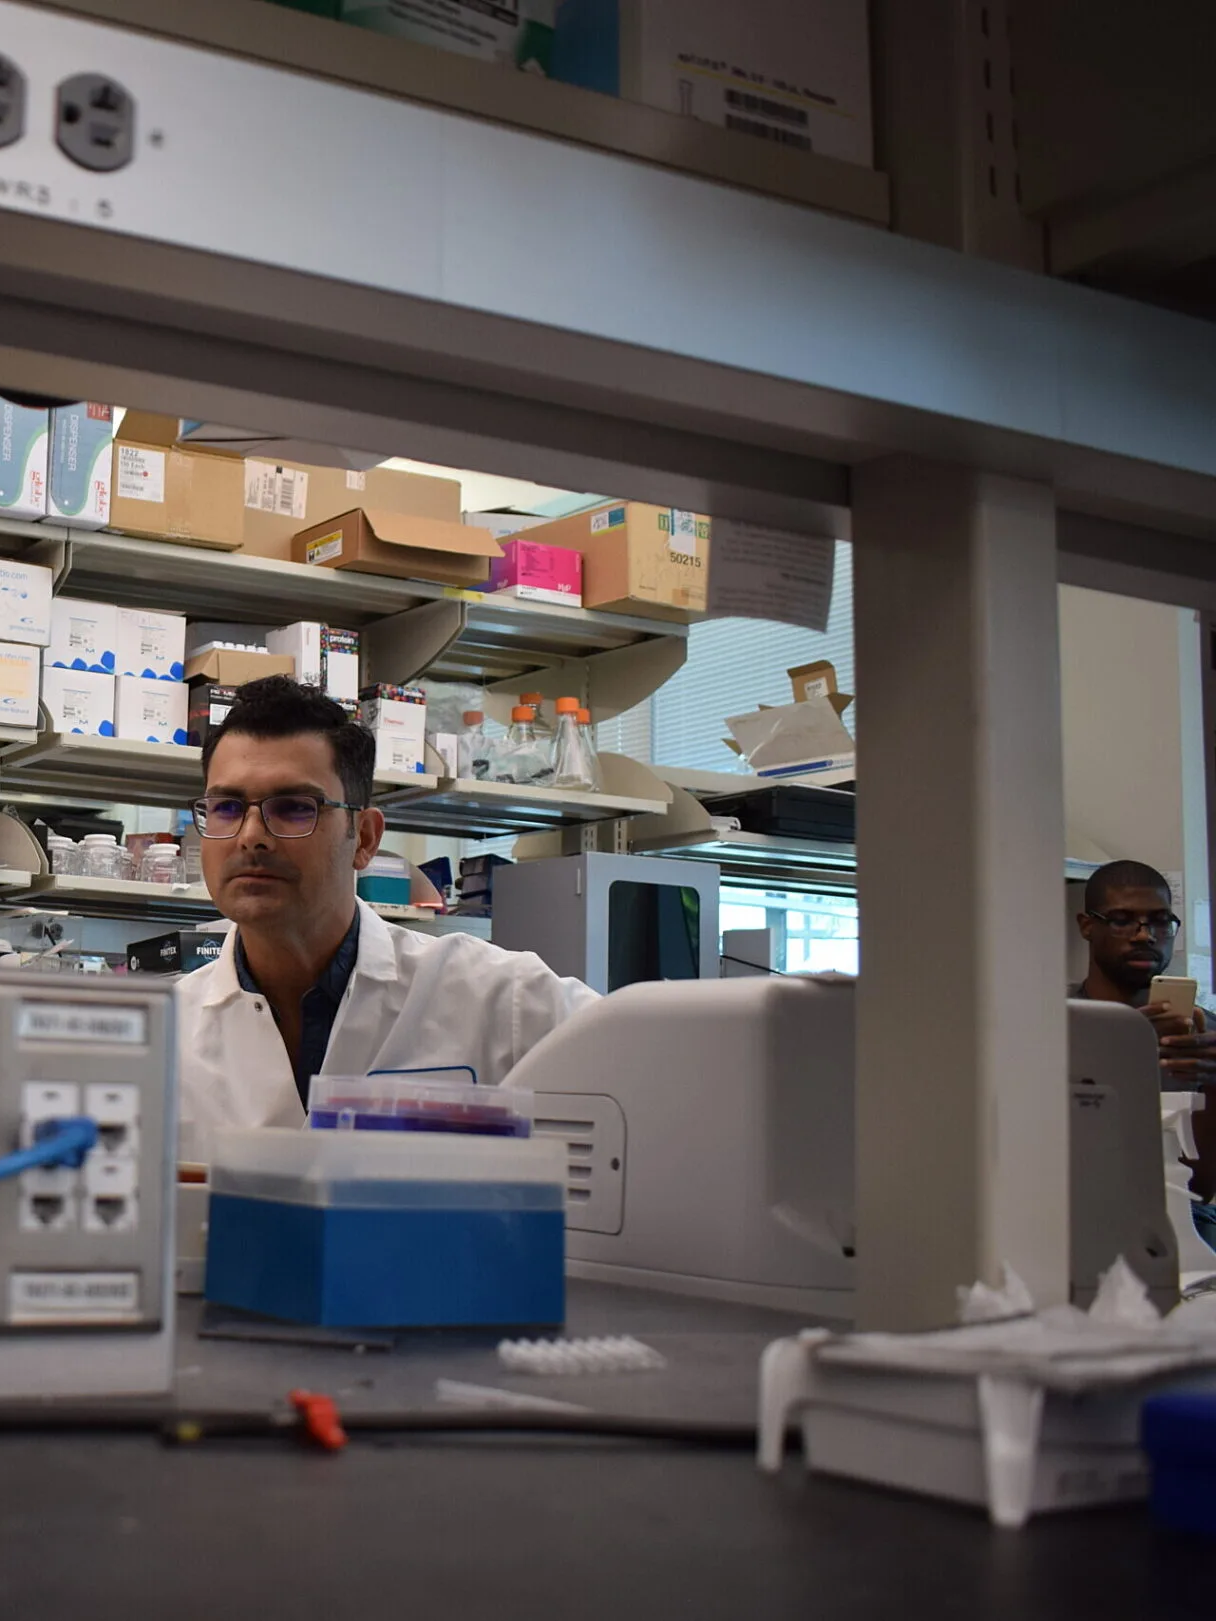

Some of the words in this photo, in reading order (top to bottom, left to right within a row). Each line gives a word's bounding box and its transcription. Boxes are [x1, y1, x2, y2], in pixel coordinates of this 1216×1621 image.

[2, 403, 14, 461] DISPENSER
[67, 414, 80, 471] DISPENSER
[669, 552, 702, 568] 50215
[159, 945, 177, 957] FINITEX
